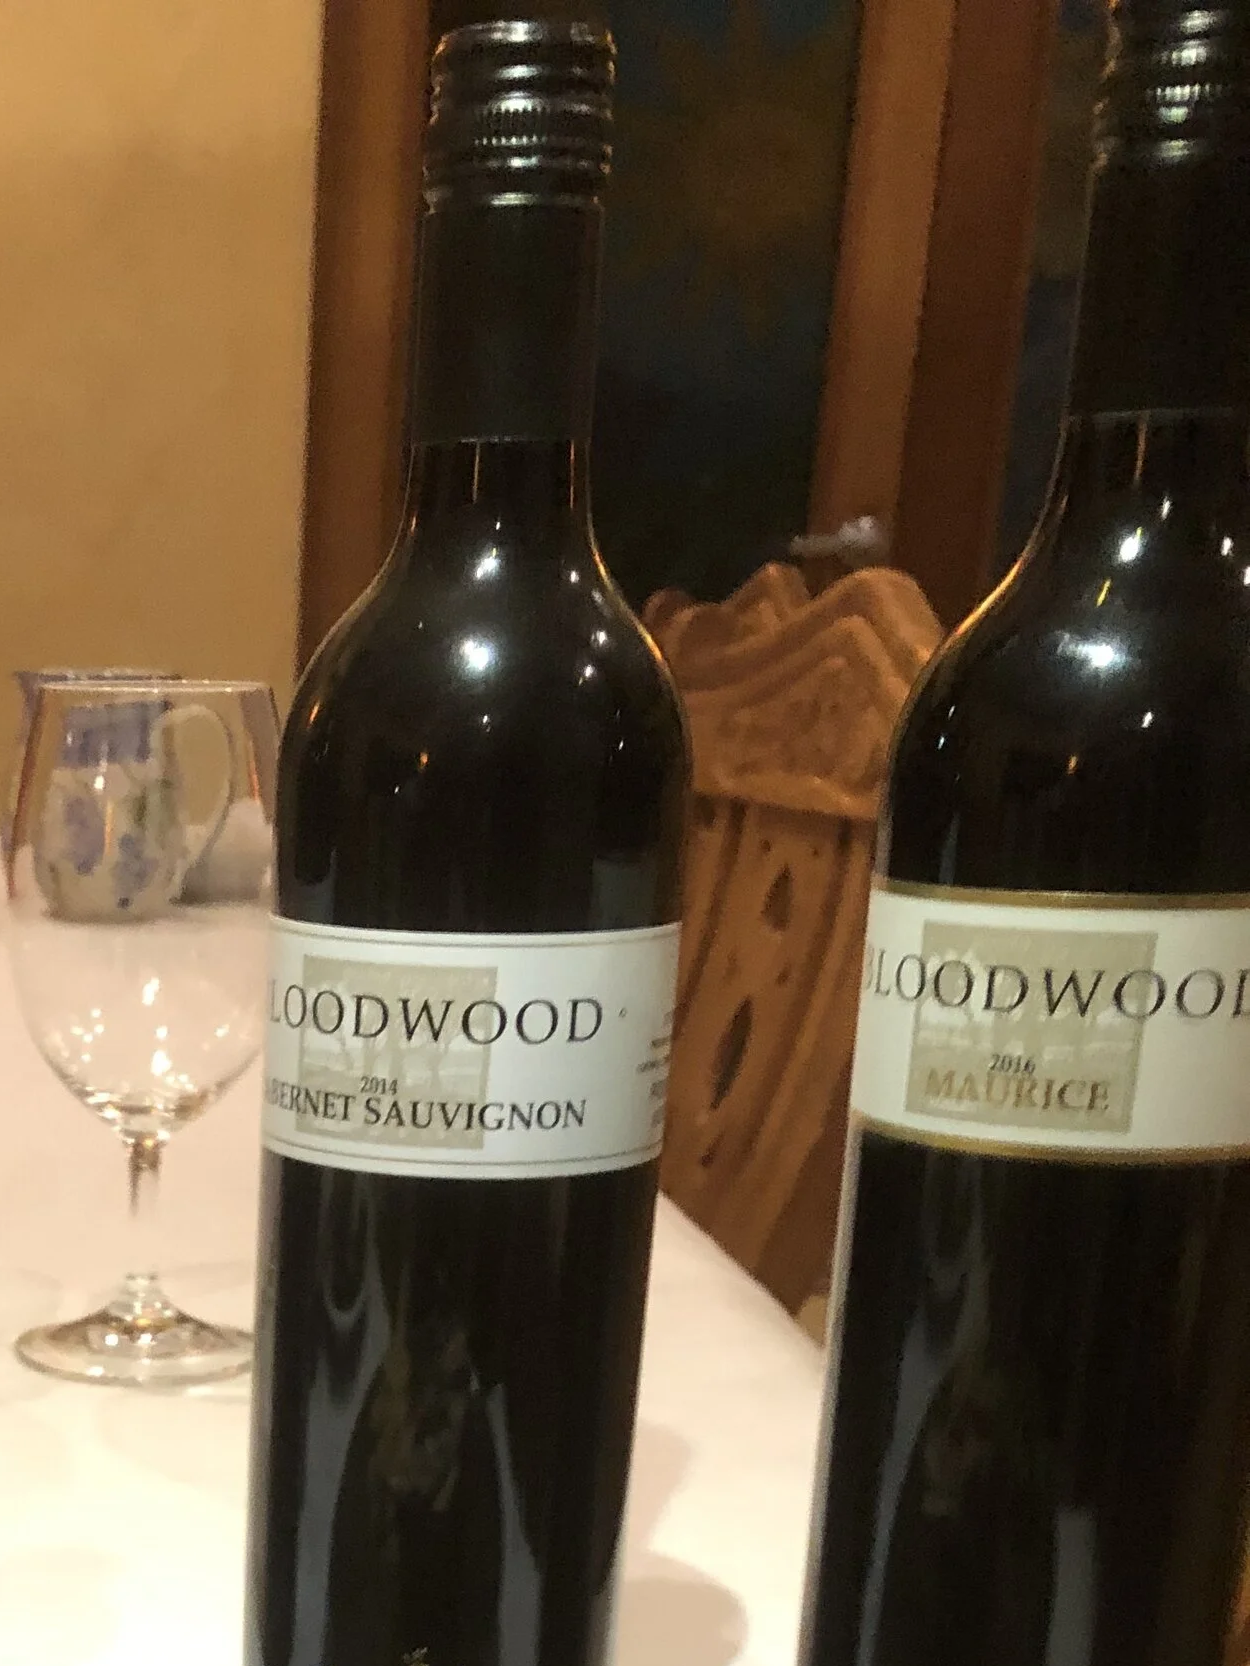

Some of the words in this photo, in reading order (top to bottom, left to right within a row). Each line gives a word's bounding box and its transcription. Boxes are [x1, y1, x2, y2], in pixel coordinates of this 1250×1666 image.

[269, 978, 604, 1045] LOODWOOD
[988, 1053, 1037, 1076] 2016
[360, 1075, 399, 1096] 2014
[924, 1067, 1110, 1112] MAURICE
[363, 1098, 587, 1132] SAUVIGNON
